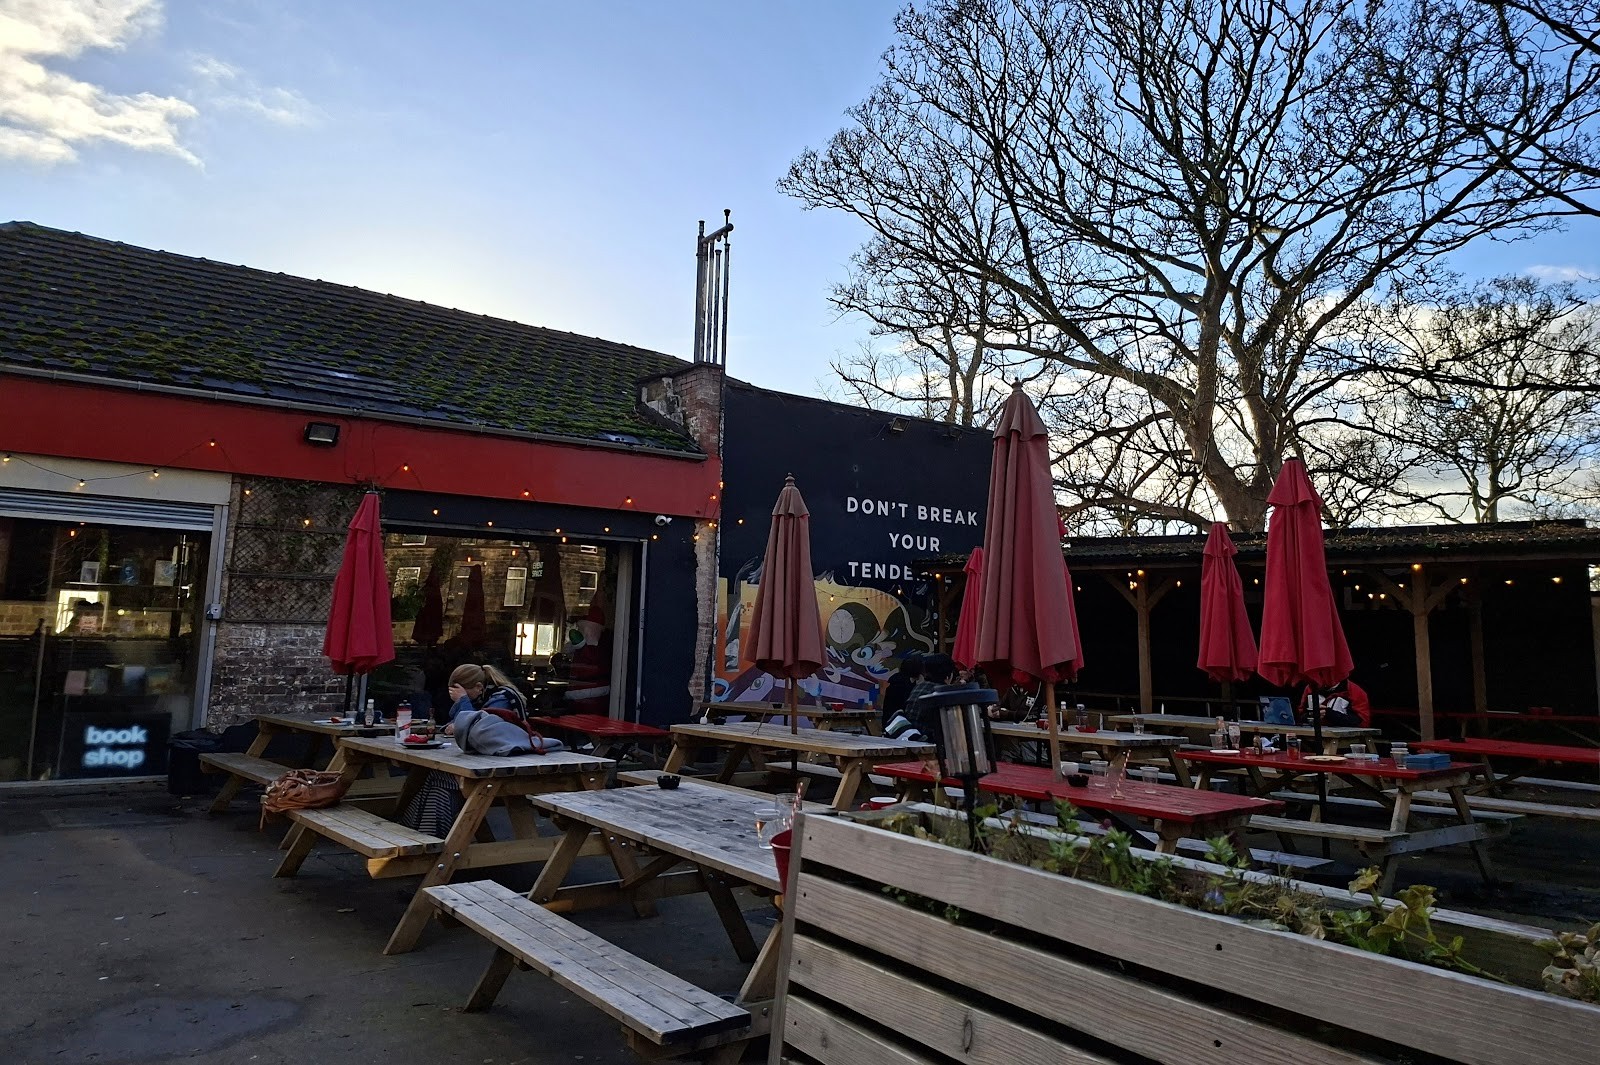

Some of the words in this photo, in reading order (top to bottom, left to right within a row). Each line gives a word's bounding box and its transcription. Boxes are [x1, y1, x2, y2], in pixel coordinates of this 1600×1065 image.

[846, 496, 909, 518] DON'T
[917, 505, 978, 526] BREAK
[888, 532, 940, 552] YOUR
[848, 561, 927, 582] TENDE
[85, 725, 147, 744] book
[83, 747, 144, 768] shop
